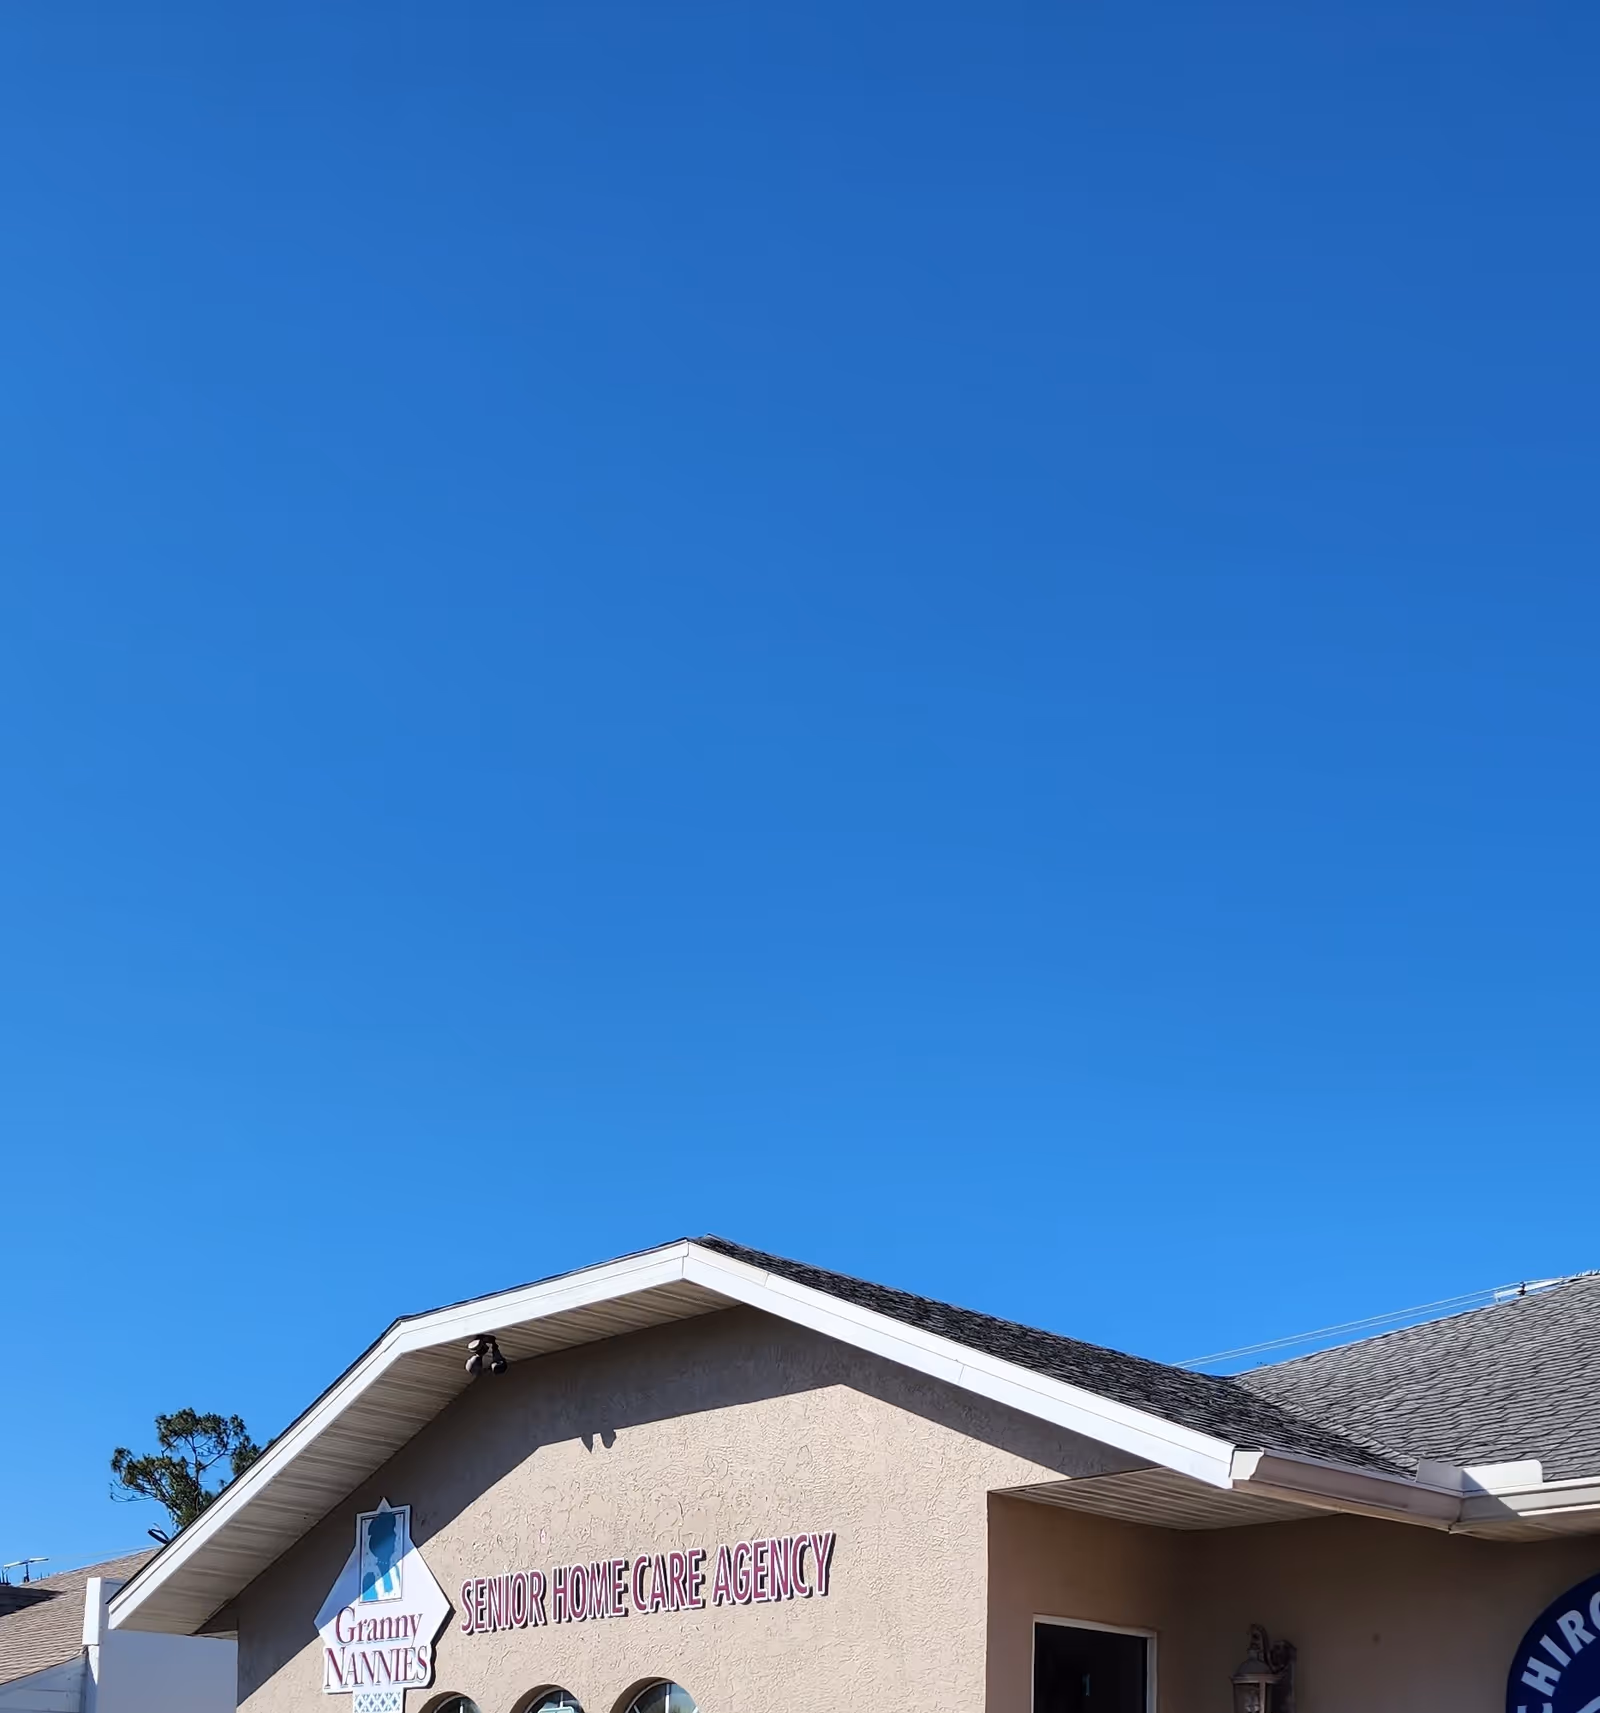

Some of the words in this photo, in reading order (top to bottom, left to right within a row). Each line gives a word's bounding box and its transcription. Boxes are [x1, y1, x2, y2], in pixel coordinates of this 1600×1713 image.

[461, 1570, 546, 1634] SENIOR
[552, 1557, 629, 1622] HOME
[632, 1547, 706, 1614] CARE
[712, 1530, 836, 1605] AGENCY
[335, 1606, 424, 1647] Granny
[325, 1644, 429, 1687] NANNIES
